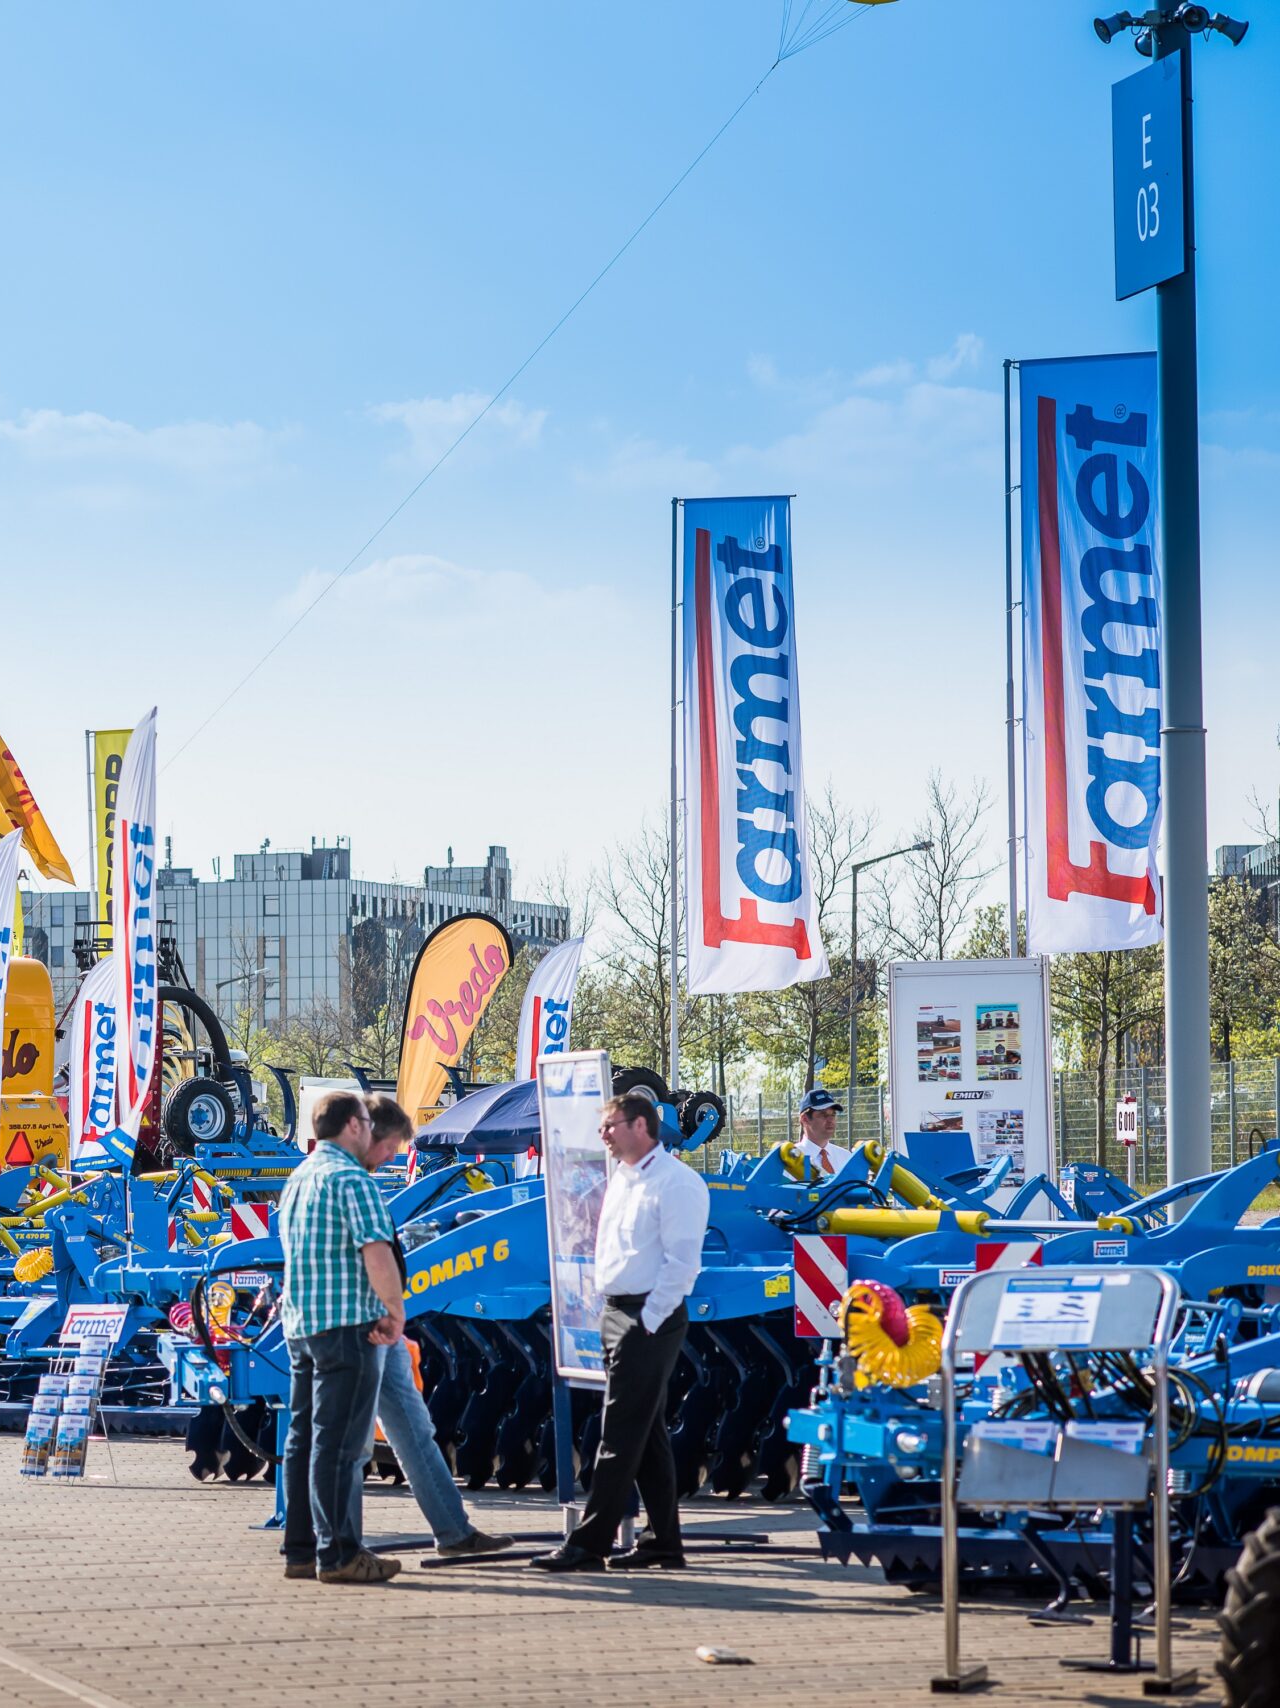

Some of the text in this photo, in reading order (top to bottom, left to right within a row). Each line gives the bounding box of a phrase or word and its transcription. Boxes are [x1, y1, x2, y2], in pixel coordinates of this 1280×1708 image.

[1141, 112, 1153, 170] E
[1136, 181, 1161, 244] 03
[1037, 395, 1161, 916] Farmet
[695, 528, 812, 961] Farmet
[406, 942, 506, 1057] Vredo
[953, 1091, 984, 1099] EMILY
[38, 1123, 51, 1131] Agri
[1118, 1111, 1135, 1131] G 010
[34, 1136, 54, 1150] Vredo
[493, 1239, 510, 1262] 6
[1095, 1241, 1126, 1256] Farmet
[234, 1271, 266, 1285] Farmet
[63, 1310, 126, 1335] Farmet
